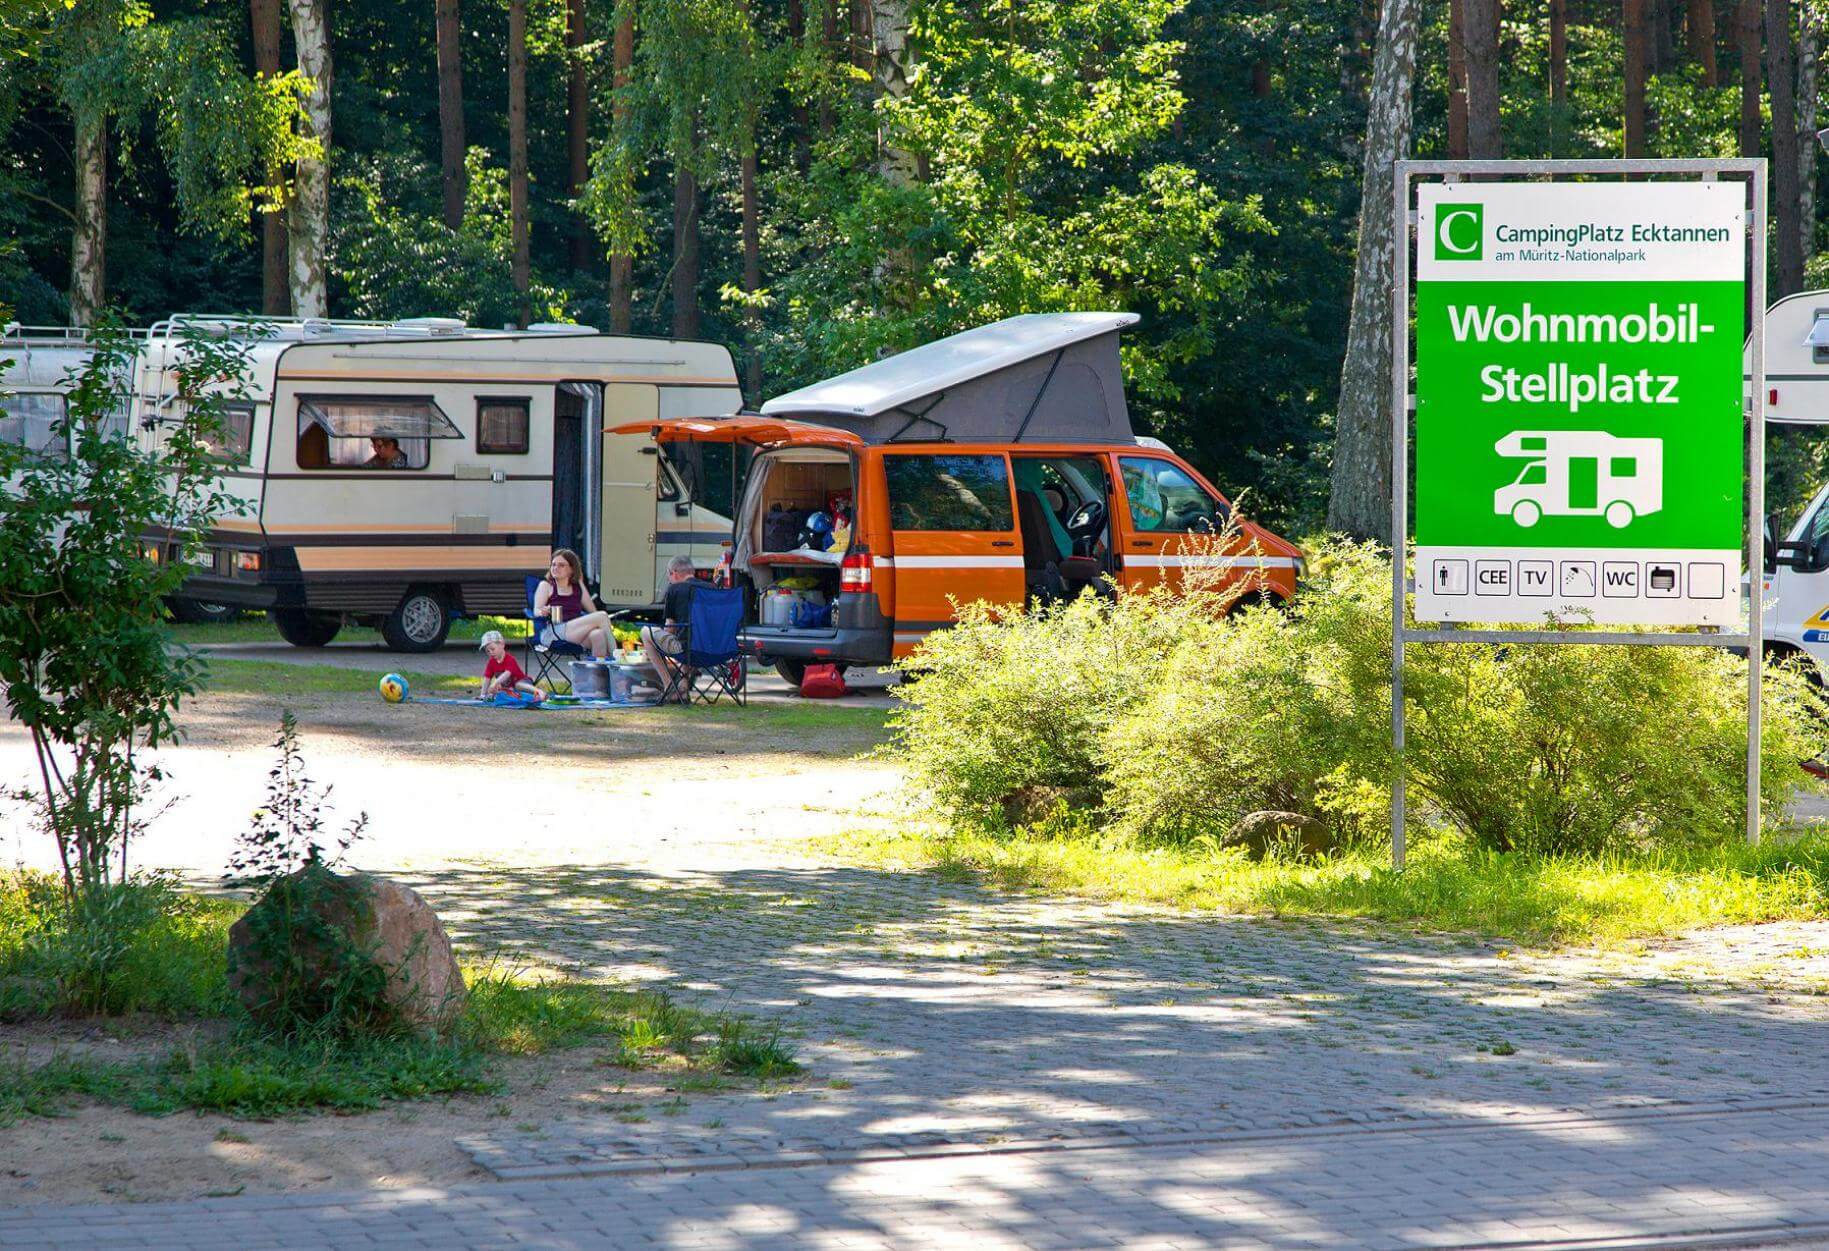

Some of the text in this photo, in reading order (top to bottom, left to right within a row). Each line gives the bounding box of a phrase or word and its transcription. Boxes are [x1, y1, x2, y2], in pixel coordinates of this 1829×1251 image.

[1439, 210, 1478, 254] C
[1495, 223, 1730, 248] CampingPlatz Ecktannen
[1495, 248, 1646, 264] am Müritz-Nationalpark
[1447, 303, 1715, 343] Wohnmobil-
[1480, 363, 1679, 413] Stellplatz
[1479, 569, 1508, 585] CEE
[1523, 570, 1548, 585] TV
[1606, 571, 1636, 587] WC
